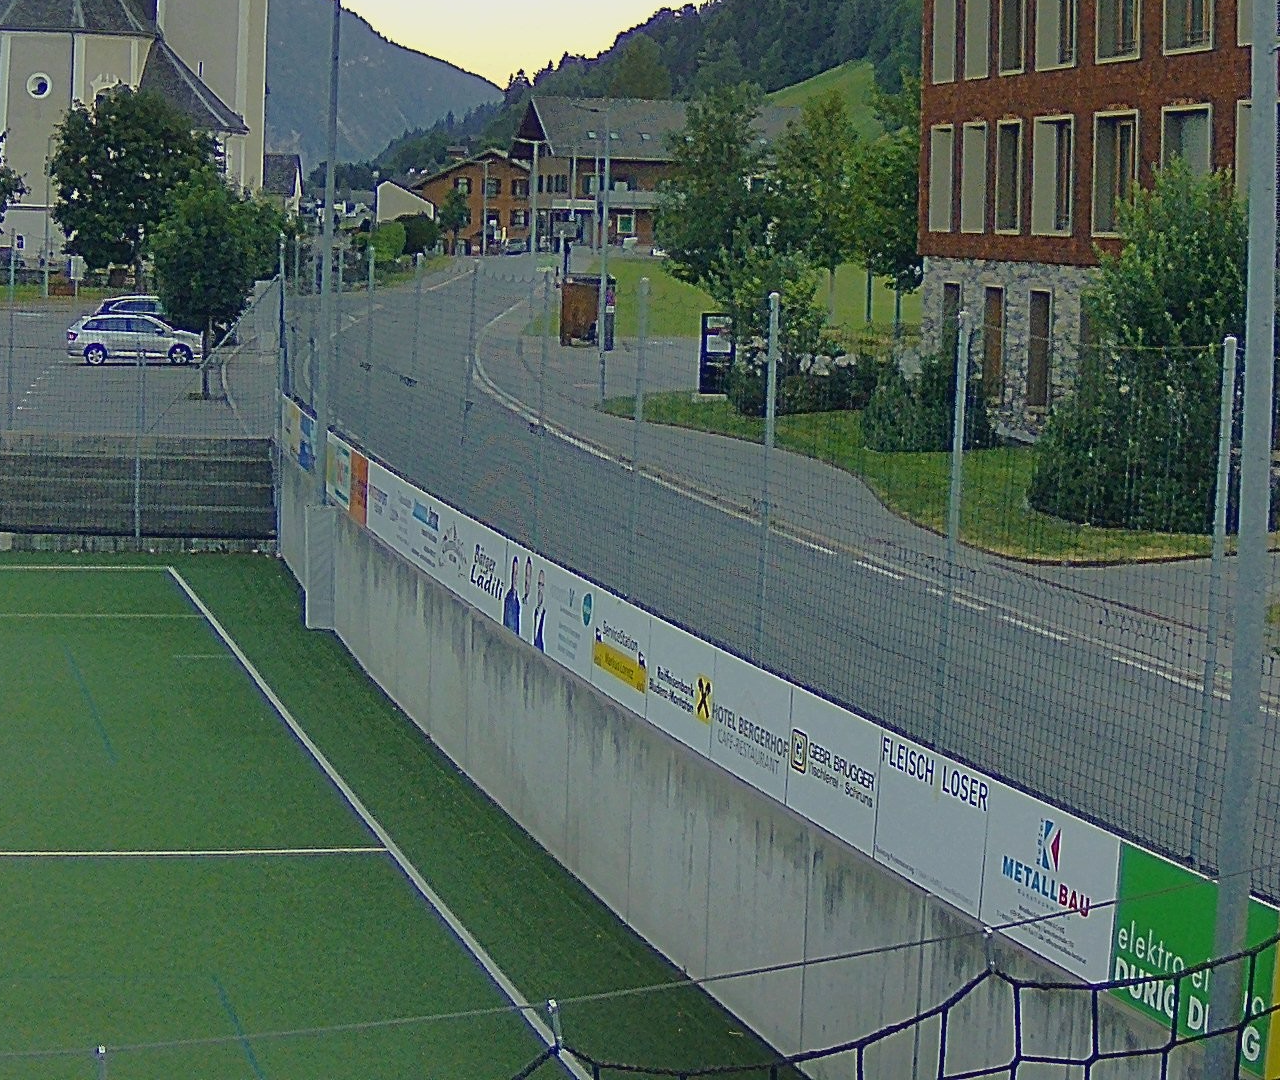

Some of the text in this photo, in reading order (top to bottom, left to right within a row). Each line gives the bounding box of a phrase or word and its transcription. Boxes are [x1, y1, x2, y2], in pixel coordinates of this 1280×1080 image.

[712, 702, 790, 759] HOTEL BERGERHOF
[882, 736, 988, 812] FLEISCH LOSER
[1002, 855, 1091, 918] METALLBAU
[1117, 919, 1184, 976] elektro
